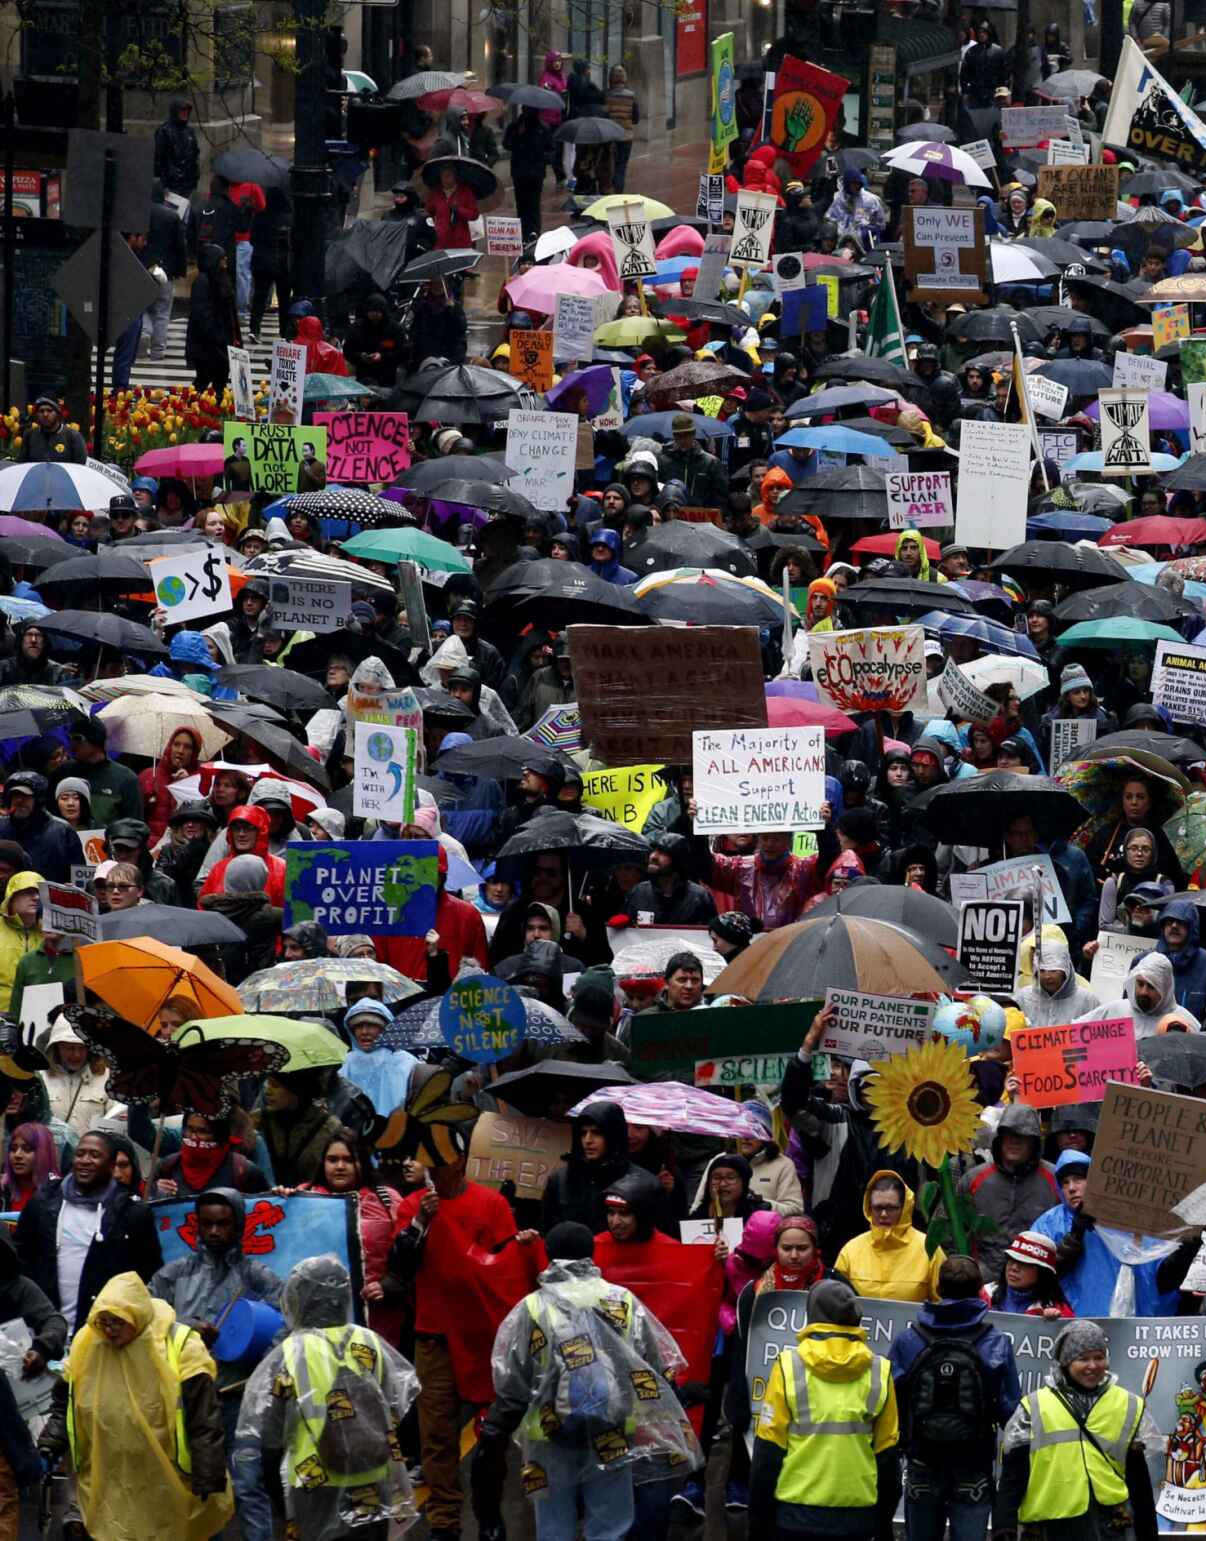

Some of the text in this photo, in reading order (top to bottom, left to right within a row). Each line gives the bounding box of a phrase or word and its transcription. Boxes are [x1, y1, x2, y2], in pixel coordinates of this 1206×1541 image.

[1130, 127, 1195, 162] OVER
[917, 215, 970, 230] Only WE
[276, 370, 297, 382] WASTE
[246, 423, 297, 438] TRUST
[532, 431, 575, 442] CLIMATE
[254, 438, 298, 462] DATA
[345, 441, 373, 455] NOT
[520, 444, 568, 457] CHANGE
[263, 463, 286, 472] not
[255, 473, 293, 492] LORE
[890, 474, 951, 494] SUPPORT
[890, 492, 937, 505] CLEAN
[908, 503, 946, 514] AIR
[289, 581, 336, 596] THERE
[292, 596, 335, 610] IS NO
[274, 613, 331, 627] PLANET
[1165, 655, 1197, 671] ANIMAL
[698, 734, 820, 756] The Majority of
[706, 755, 826, 775] ALL AMERICANS
[362, 783, 385, 795] WITH
[628, 773, 645, 792] IS
[738, 778, 795, 800] Support
[362, 798, 381, 811] HER
[624, 804, 638, 823] B
[695, 803, 788, 825] CLEAN ENERGY
[315, 867, 401, 886] PLANET
[321, 885, 384, 904] OVER
[313, 905, 398, 926] PROFIT
[962, 907, 1017, 943] NO!
[449, 986, 511, 1011] SCIENCE
[830, 993, 912, 1014] OUR PLANET
[841, 1008, 927, 1029] OUR PATIENTS
[827, 1017, 925, 1040] OUR FUTURE
[1015, 1021, 1126, 1051] CLIMATE CHANGE
[453, 1028, 518, 1055] SILENCE
[1022, 1063, 1137, 1096] FOOD SCARCITY
[1112, 1094, 1187, 1124] PEOPLE
[1119, 1122, 1195, 1155] PLANET
[473, 1162, 513, 1185] THE
[1100, 1157, 1190, 1190] CORPORATE
[1104, 1176, 1181, 1206] PROFITS
[1135, 1326, 1149, 1340] IT
[1155, 1324, 1199, 1341] TAKES
[1127, 1345, 1172, 1360] GROW
[1176, 1345, 1202, 1359] THE
[1163, 1501, 1197, 1516] Cultivar
